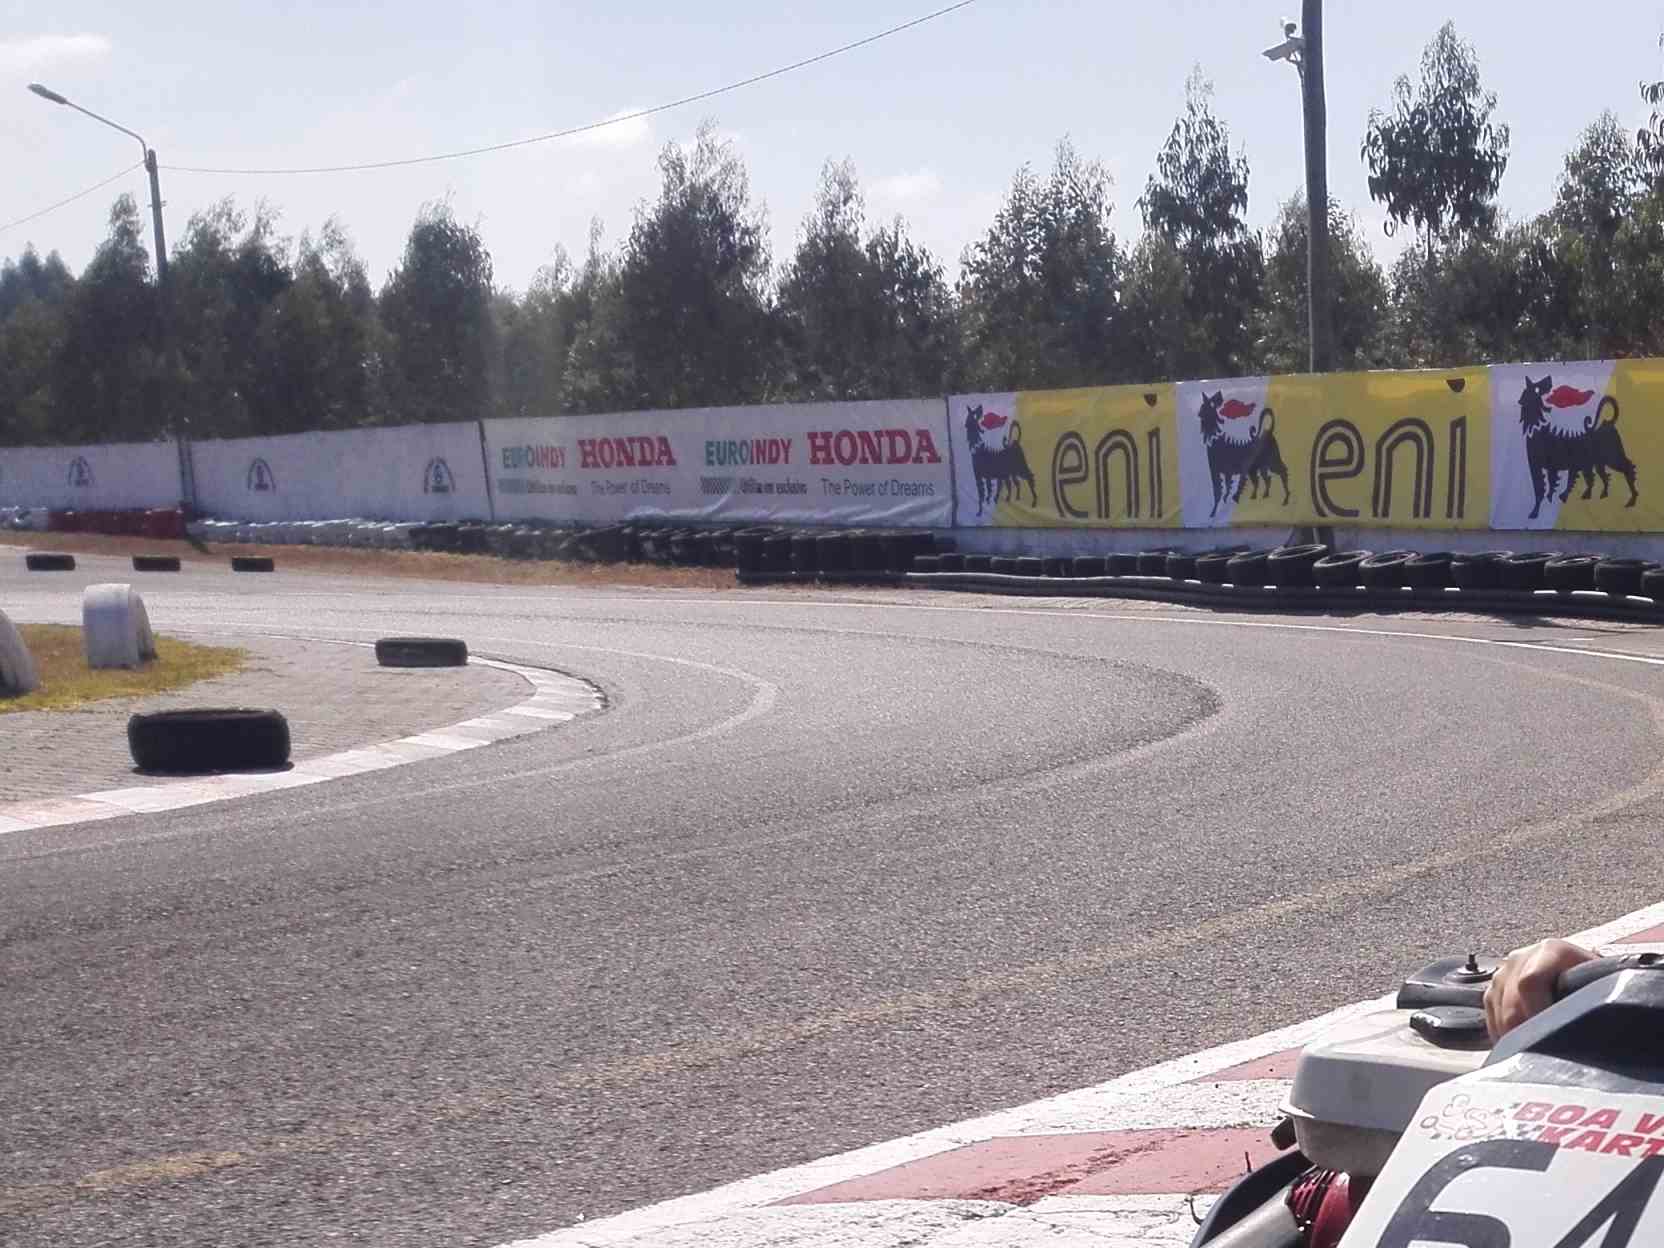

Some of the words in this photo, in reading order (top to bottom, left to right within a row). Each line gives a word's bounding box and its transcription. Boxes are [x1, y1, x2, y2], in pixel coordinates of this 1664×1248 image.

[577, 436, 677, 468] HONDA
[807, 429, 942, 465] HONDA
[1051, 394, 1163, 519] eni
[1310, 378, 1467, 519] eni
[820, 478, 842, 496] The
[844, 478, 877, 496] Power
[891, 479, 935, 497] Dreams
[1512, 1101, 1616, 1133] BOA
